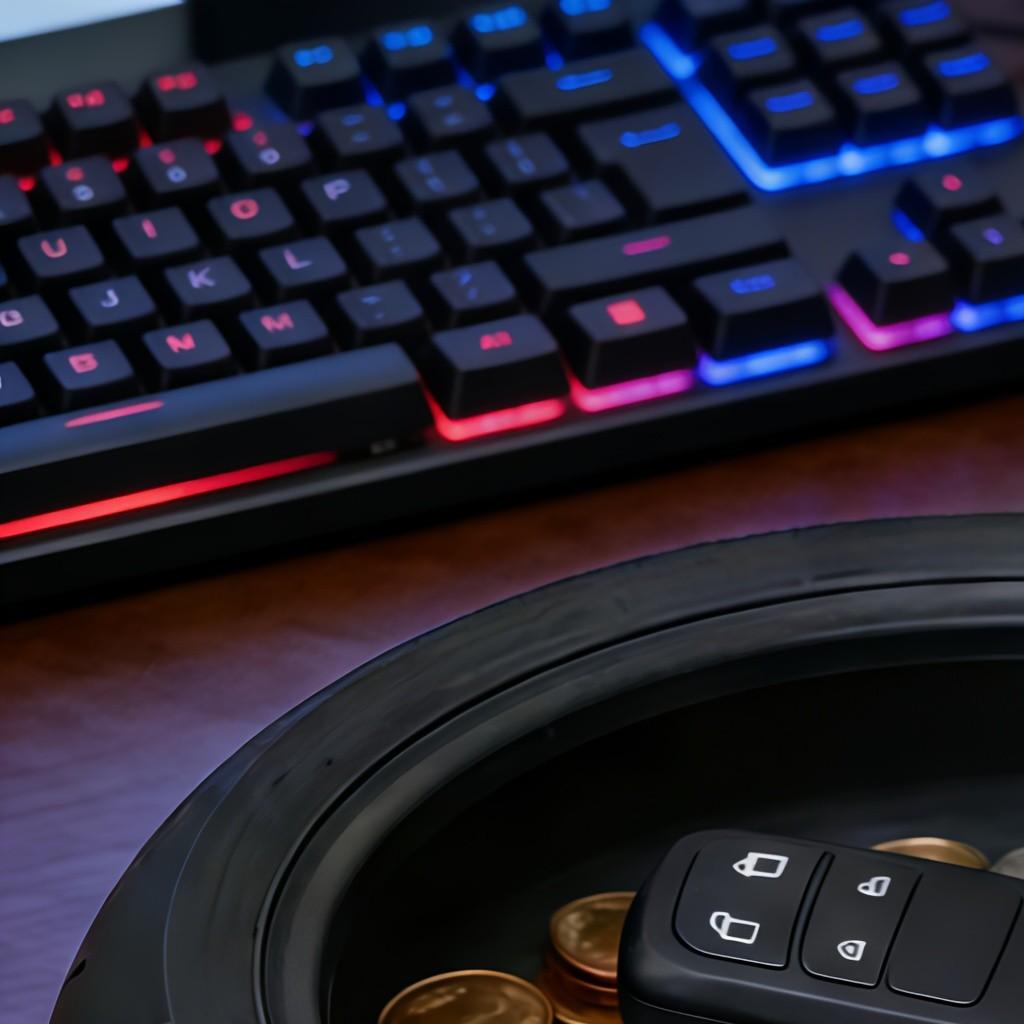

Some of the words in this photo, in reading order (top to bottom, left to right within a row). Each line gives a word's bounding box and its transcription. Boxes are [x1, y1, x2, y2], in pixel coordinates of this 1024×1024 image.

[323, 178, 351, 200] P
[230, 198, 259, 219] O
[141, 219, 157, 239] I
[41, 237, 68, 258] U
[283, 249, 312, 269] L
[187, 267, 215, 289] K
[101, 289, 119, 308] J
[260, 312, 294, 333] M
[165, 332, 196, 353] N
